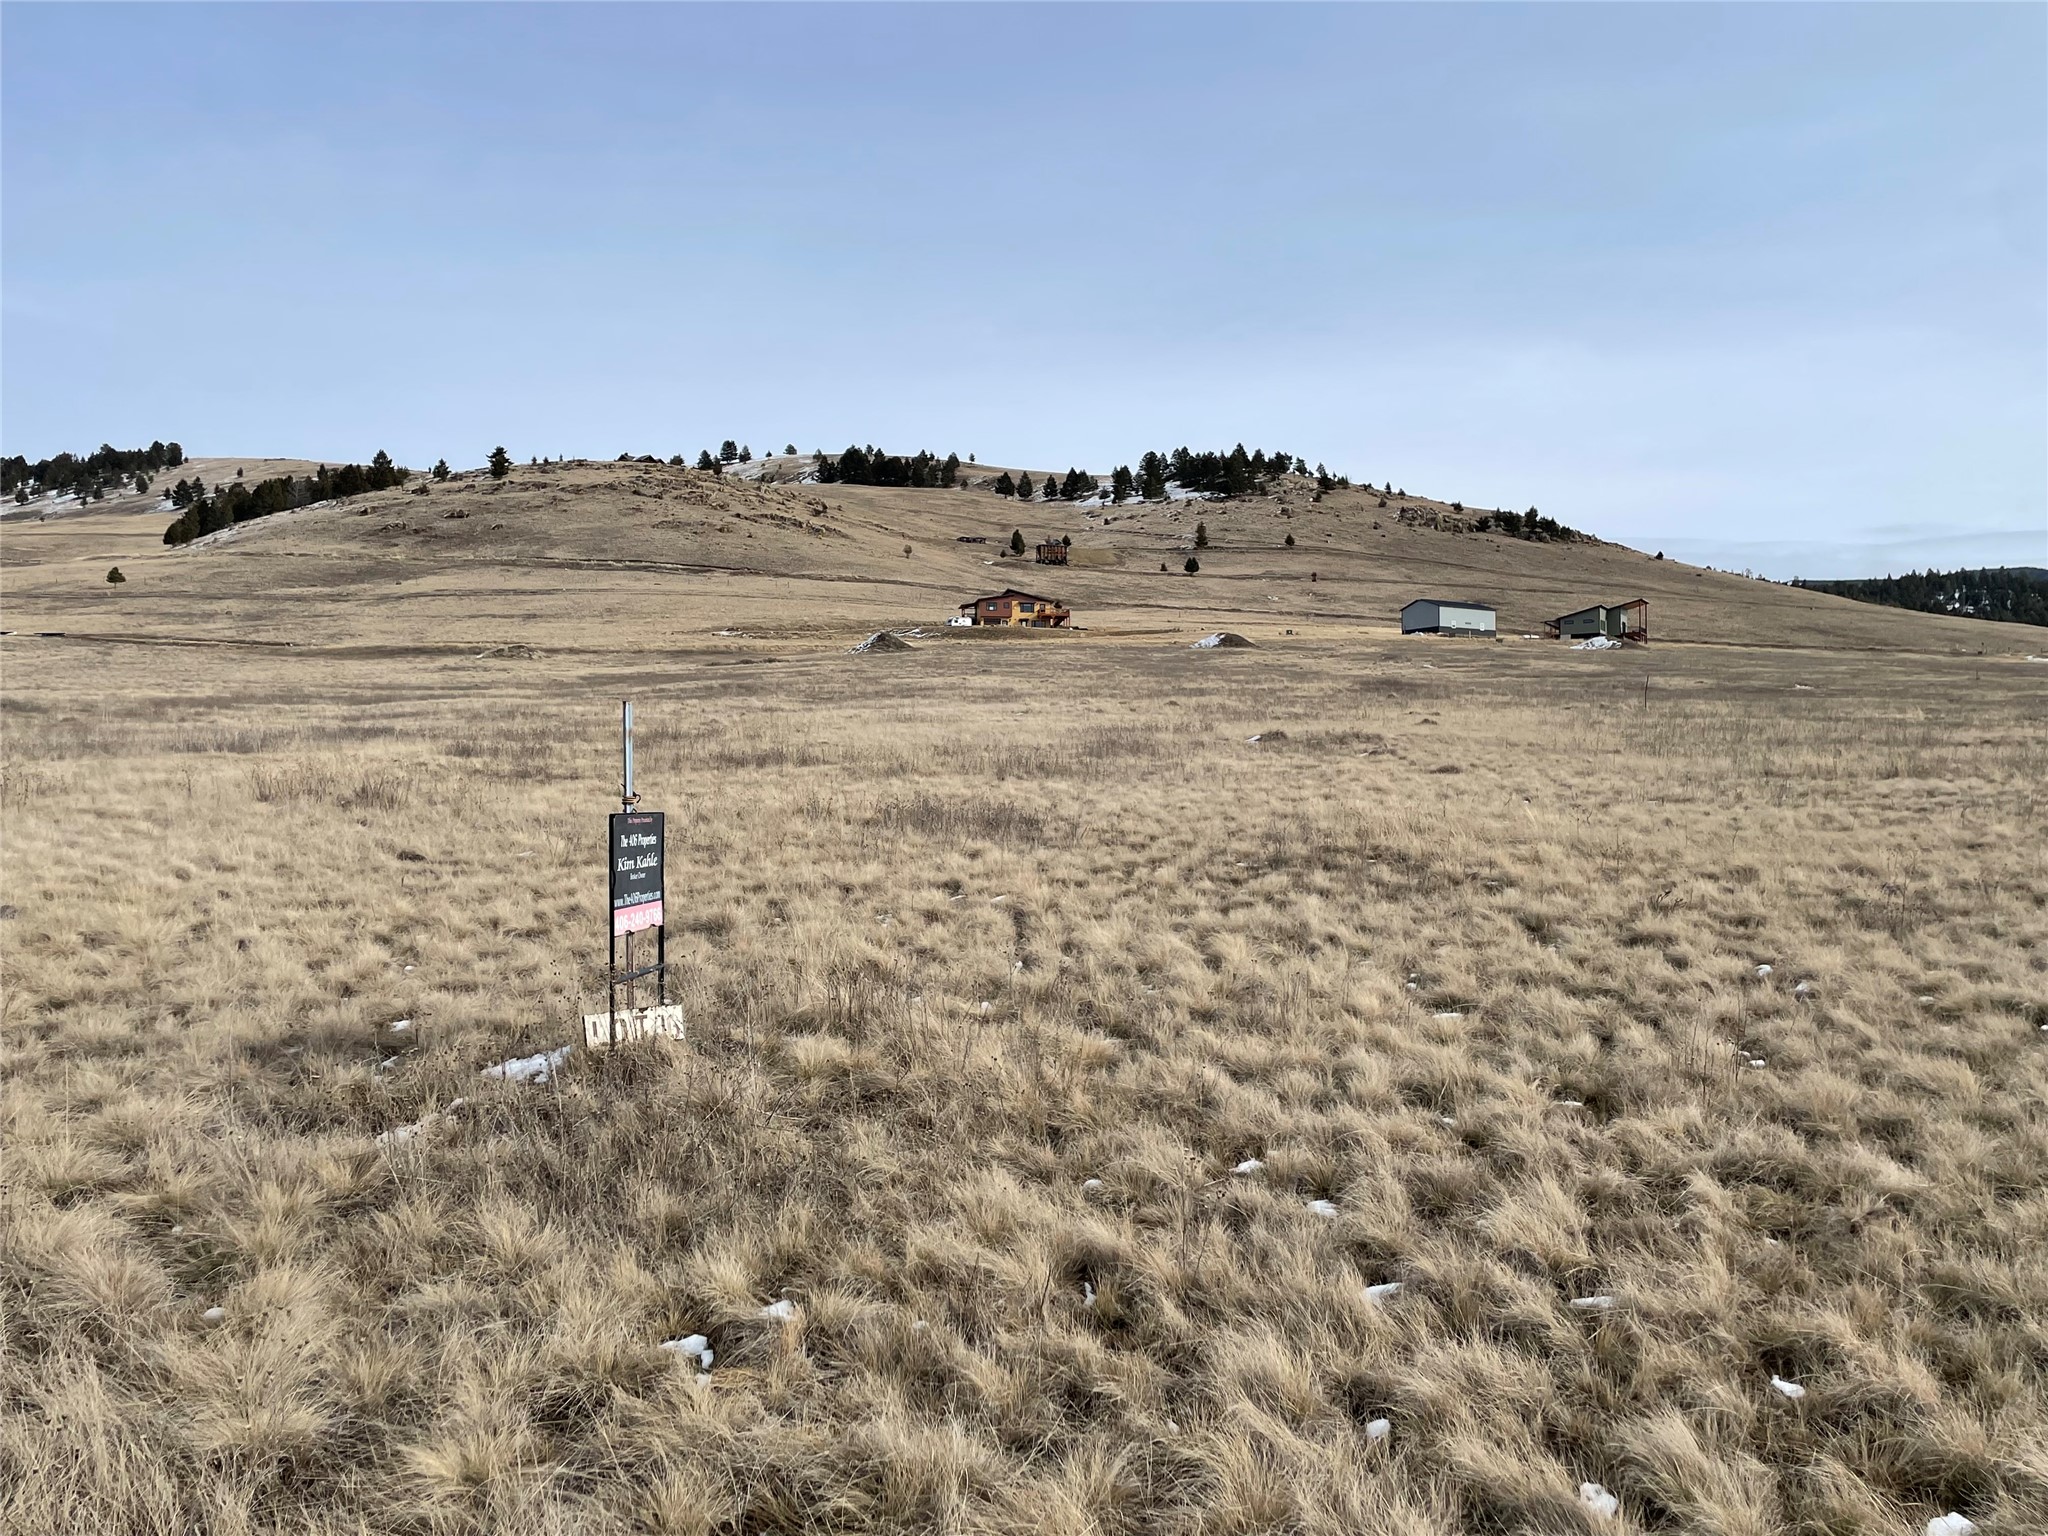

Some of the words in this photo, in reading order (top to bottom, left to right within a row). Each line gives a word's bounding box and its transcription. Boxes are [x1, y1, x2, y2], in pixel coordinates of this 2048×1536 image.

[620, 834, 628, 848] The
[629, 833, 637, 847] 406
[638, 833, 657, 849] Properties
[617, 856, 635, 872] Kim
[636, 852, 658, 869] Kahle
